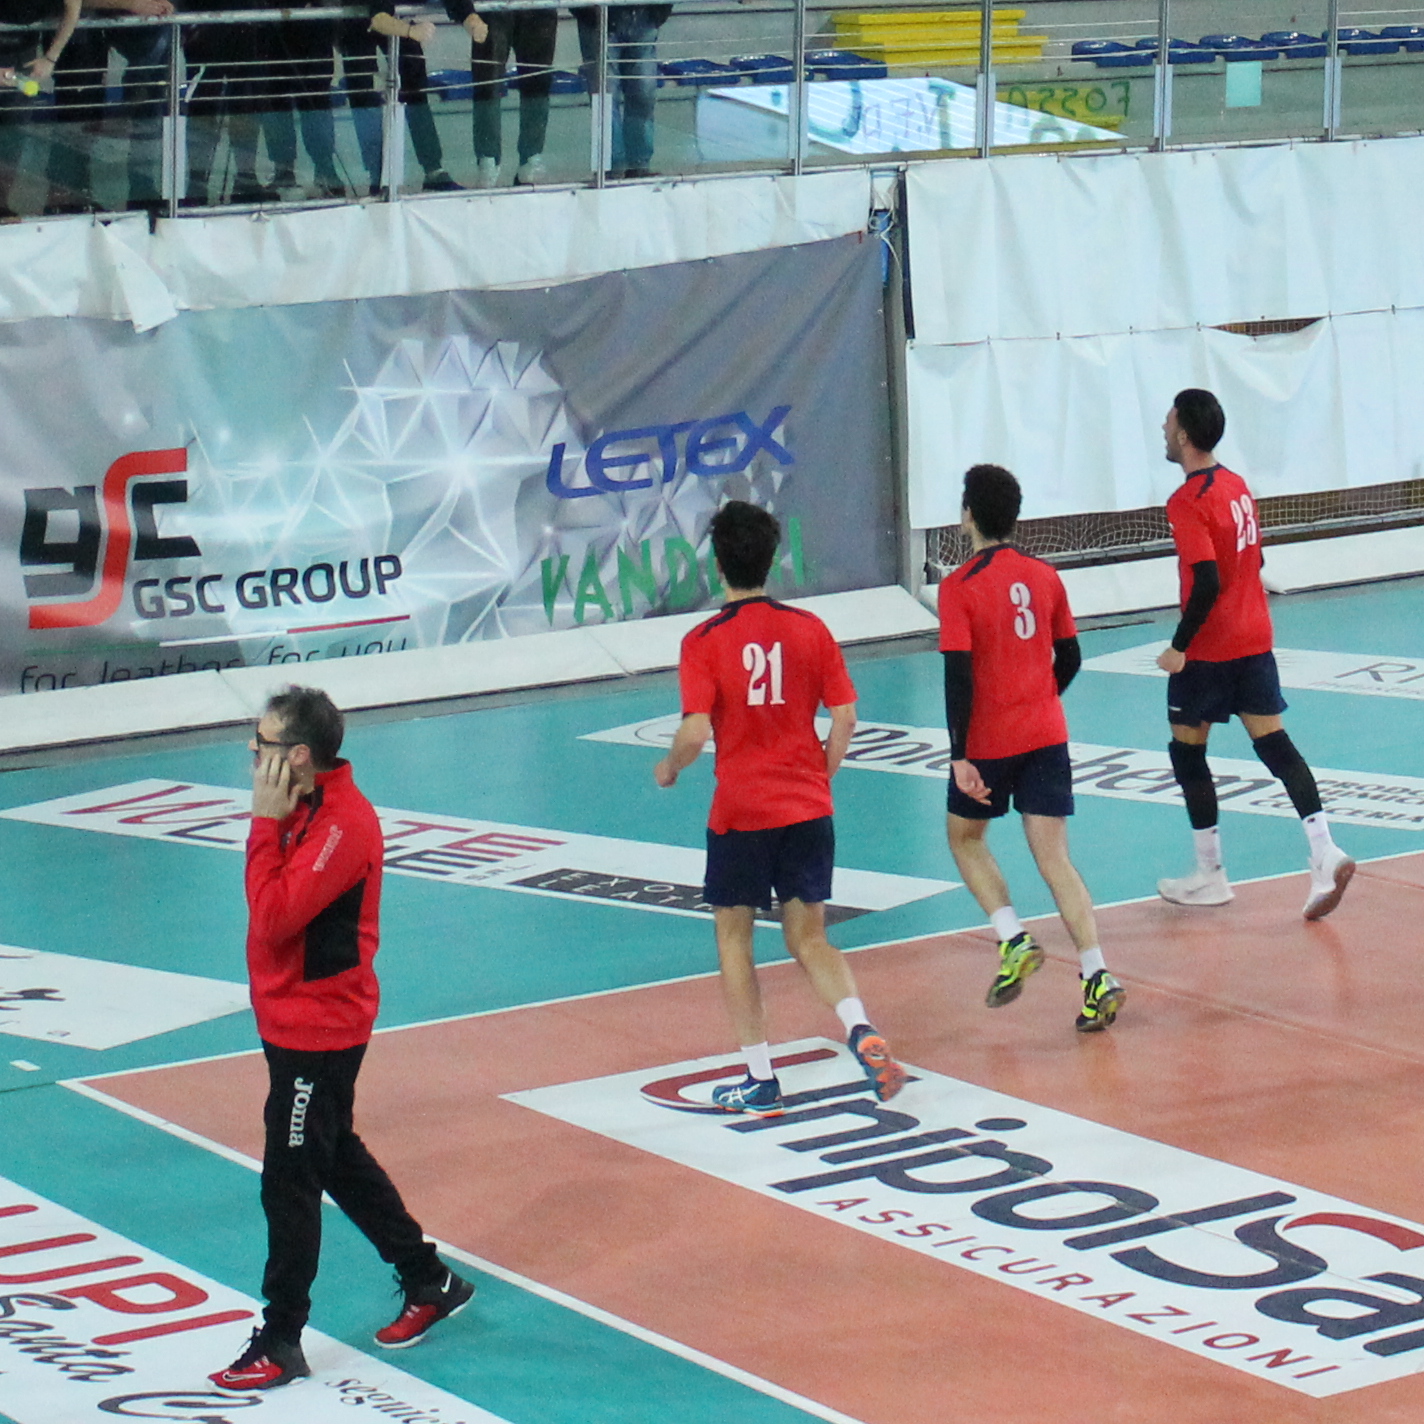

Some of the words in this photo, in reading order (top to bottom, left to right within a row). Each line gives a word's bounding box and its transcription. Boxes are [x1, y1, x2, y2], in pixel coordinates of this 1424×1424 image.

[545, 404, 796, 500] LETEX
[131, 571, 227, 621] GSC
[234, 552, 406, 615] GROUP
[1008, 581, 1039, 640] 3
[741, 640, 786, 707] 21
[286, 1076, 315, 1147] Joma
[818, 1190, 1343, 1382] ASSICURAZIONI
